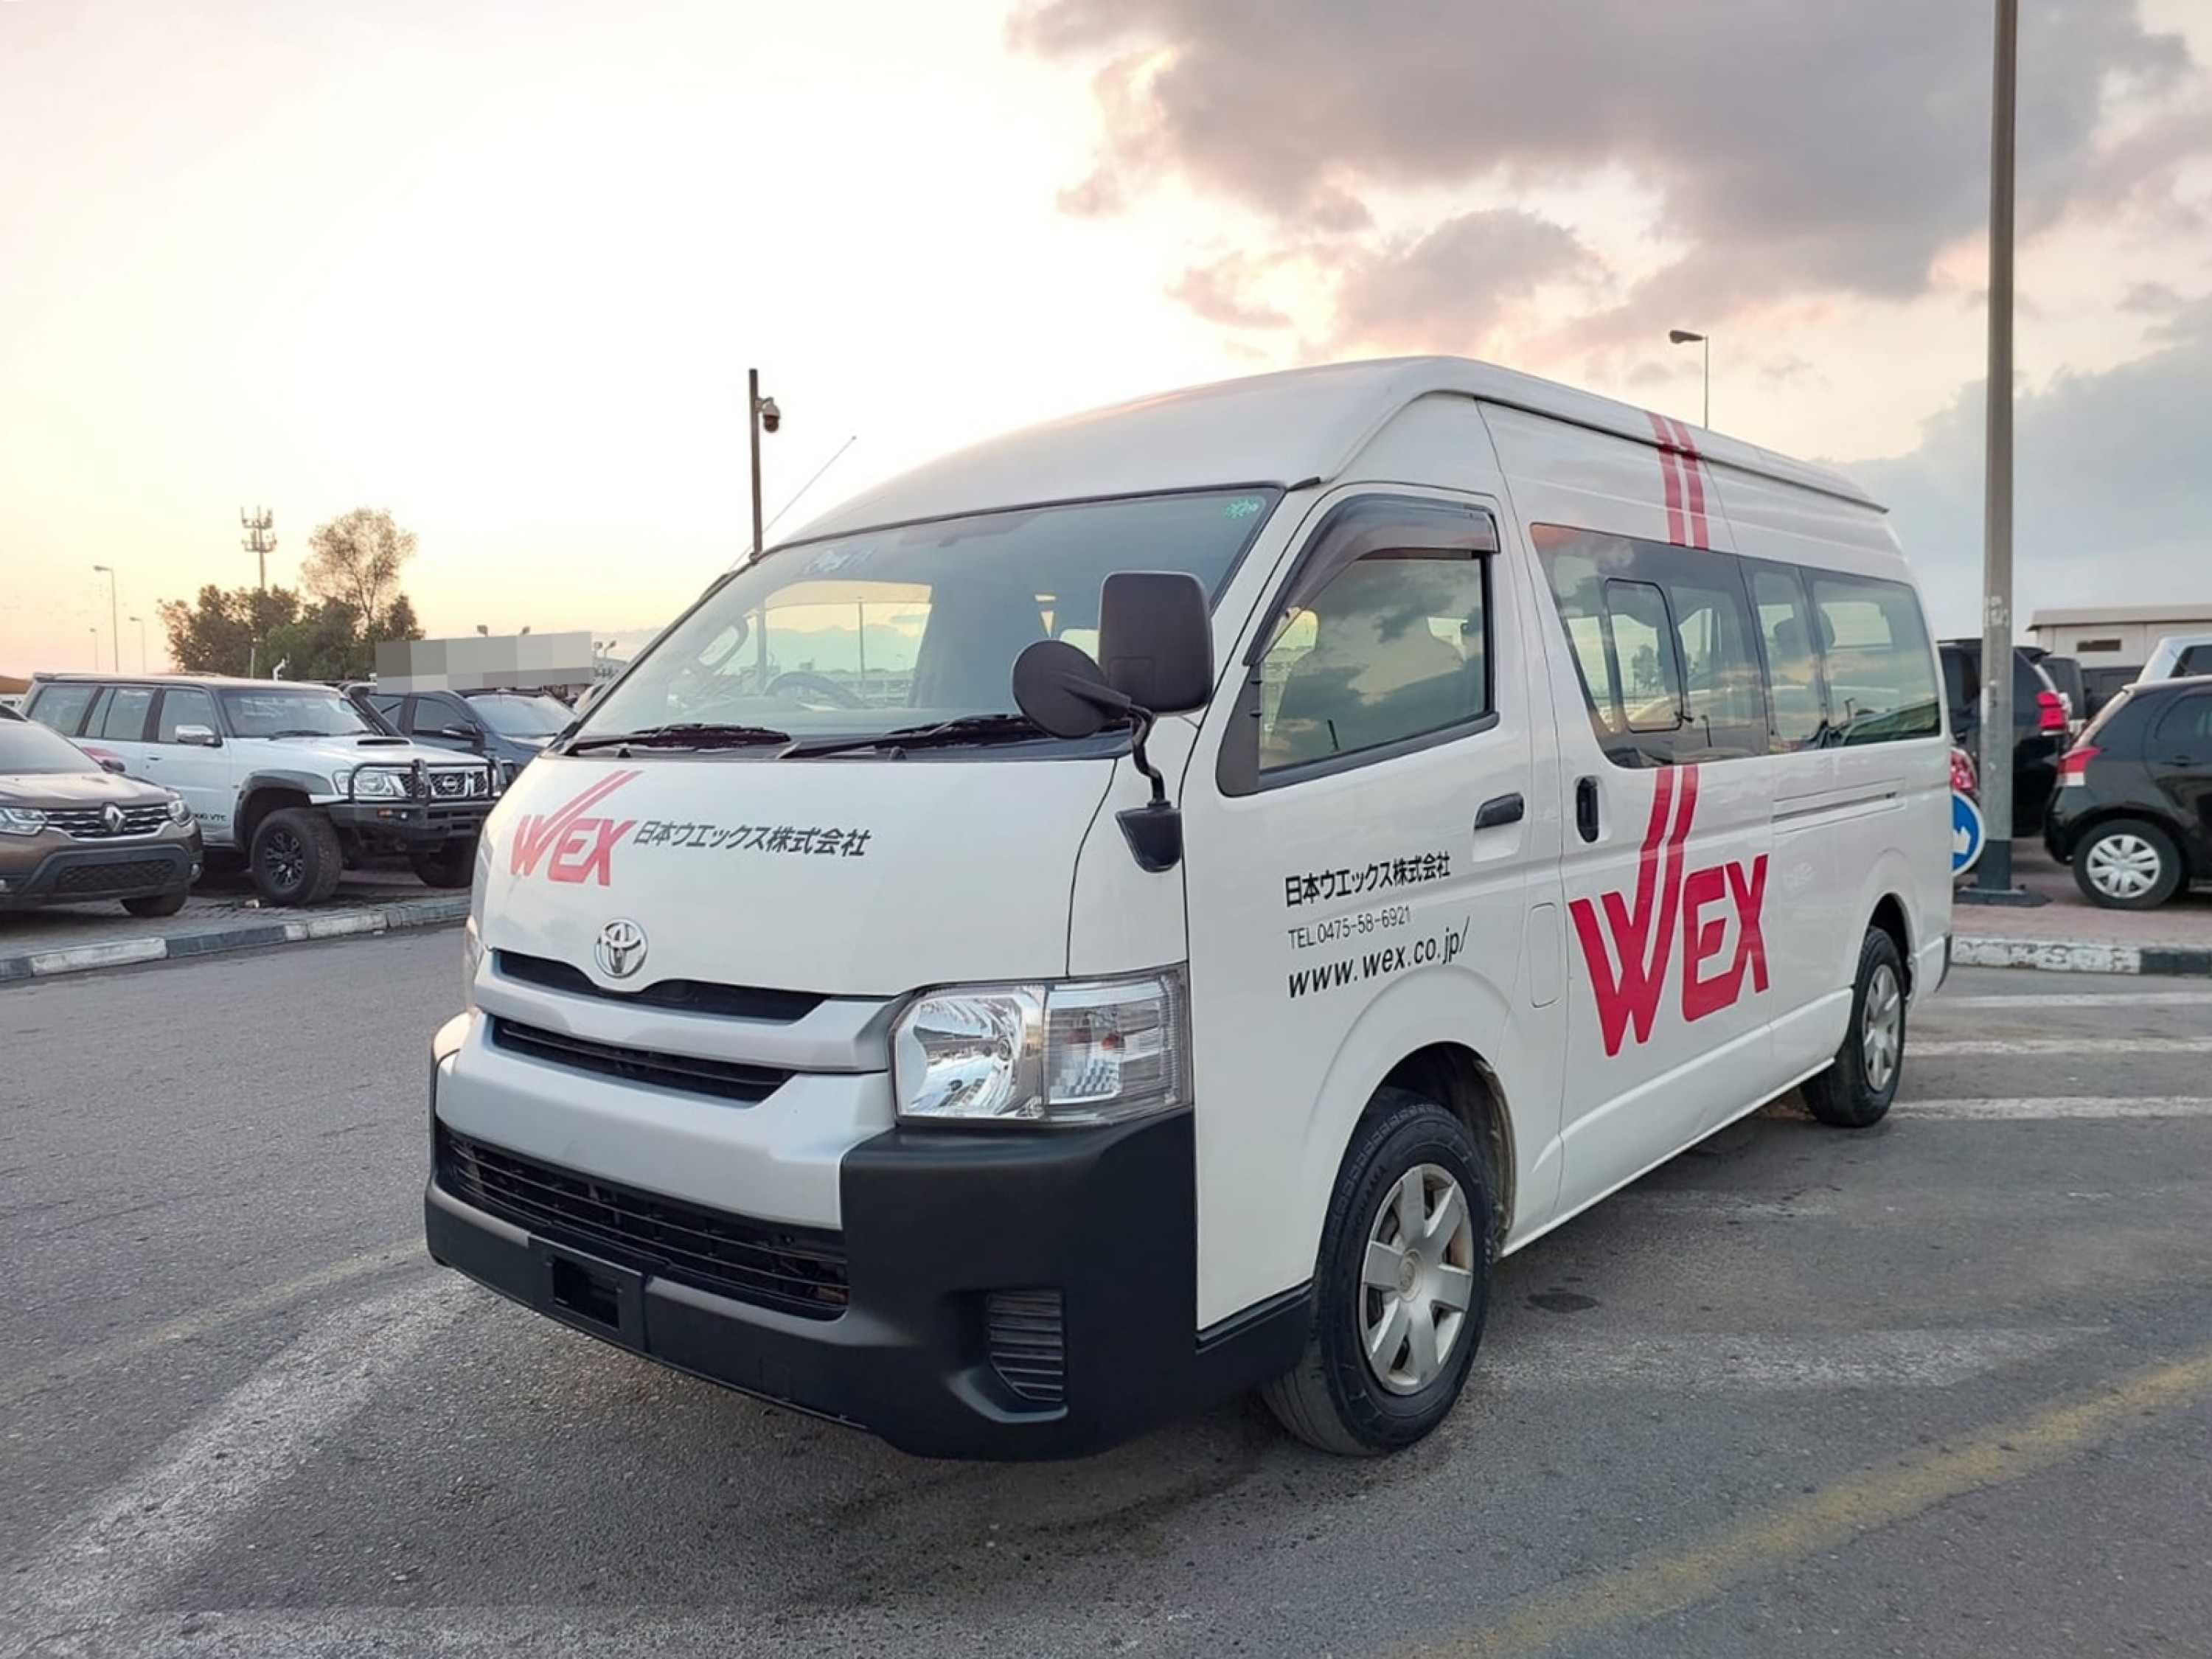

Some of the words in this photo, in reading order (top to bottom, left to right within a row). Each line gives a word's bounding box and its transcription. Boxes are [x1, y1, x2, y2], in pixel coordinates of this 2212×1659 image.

[509, 770, 643, 886] WEX
[633, 821, 871, 857] 日本ウエックス株式会社
[1285, 850, 1450, 907] 日本ウエックス株式会社
[1568, 764, 1769, 1057] WEX
[1289, 915, 1471, 998] www.wex.co.jp/
